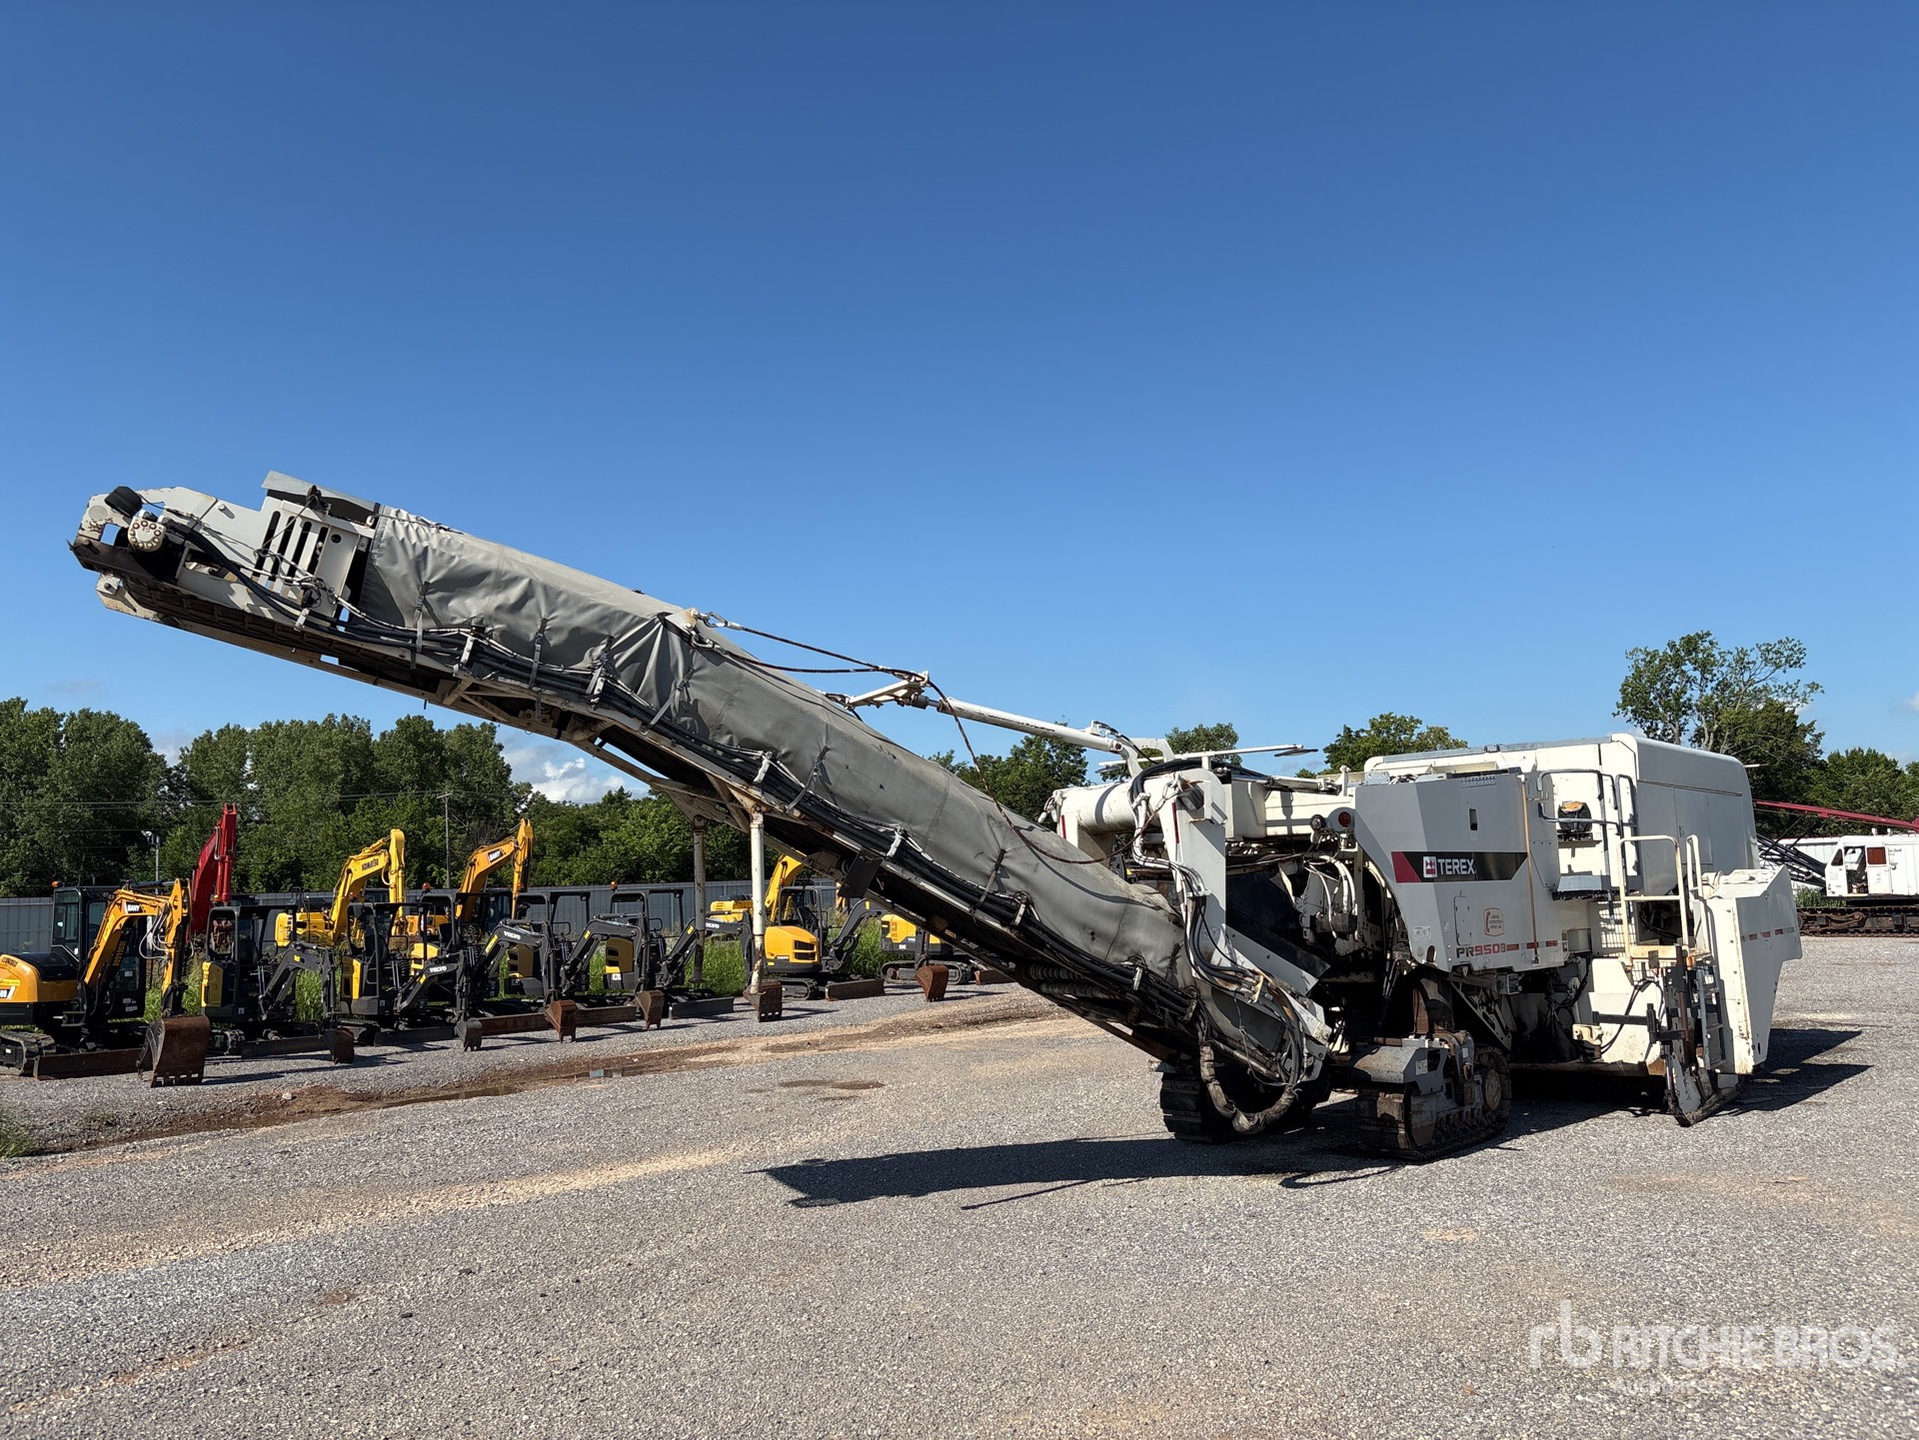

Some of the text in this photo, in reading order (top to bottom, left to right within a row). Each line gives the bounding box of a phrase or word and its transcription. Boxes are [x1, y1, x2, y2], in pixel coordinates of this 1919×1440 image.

[1437, 858, 1475, 875] TEREX
[504, 930, 521, 940] VOLVO
[429, 965, 447, 973] VOLVO
